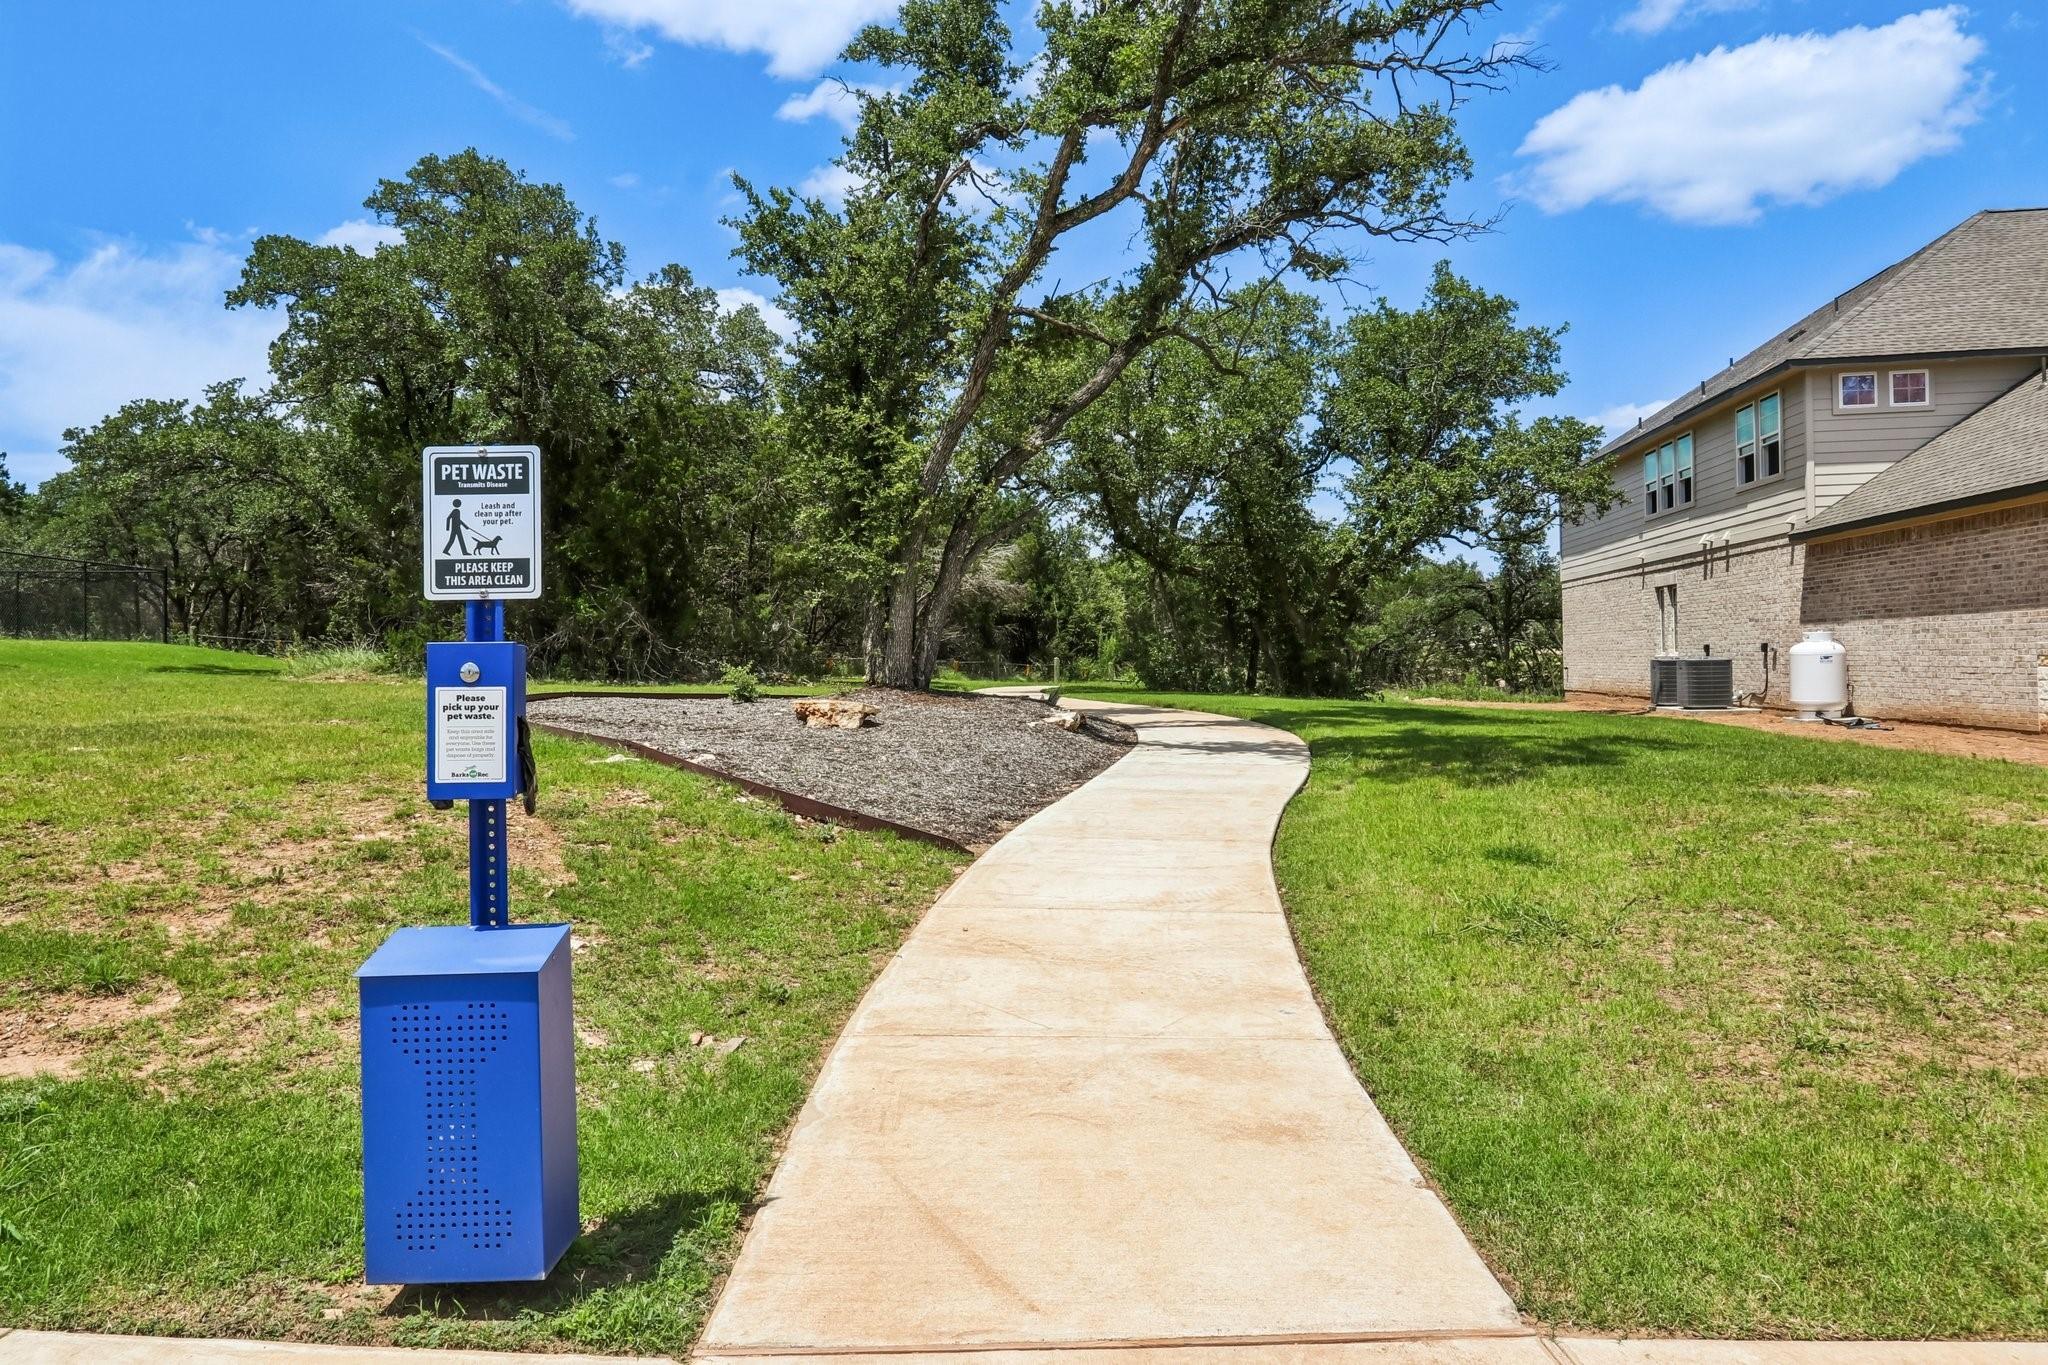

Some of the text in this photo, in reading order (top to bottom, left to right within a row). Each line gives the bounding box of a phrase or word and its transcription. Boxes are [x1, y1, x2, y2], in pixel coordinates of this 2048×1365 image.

[442, 464, 523, 480] PET WASTE
[455, 562, 514, 573] PLEASE KEEP
[445, 575, 523, 585] THIS AREA CLEAN
[443, 704, 462, 712] pick
